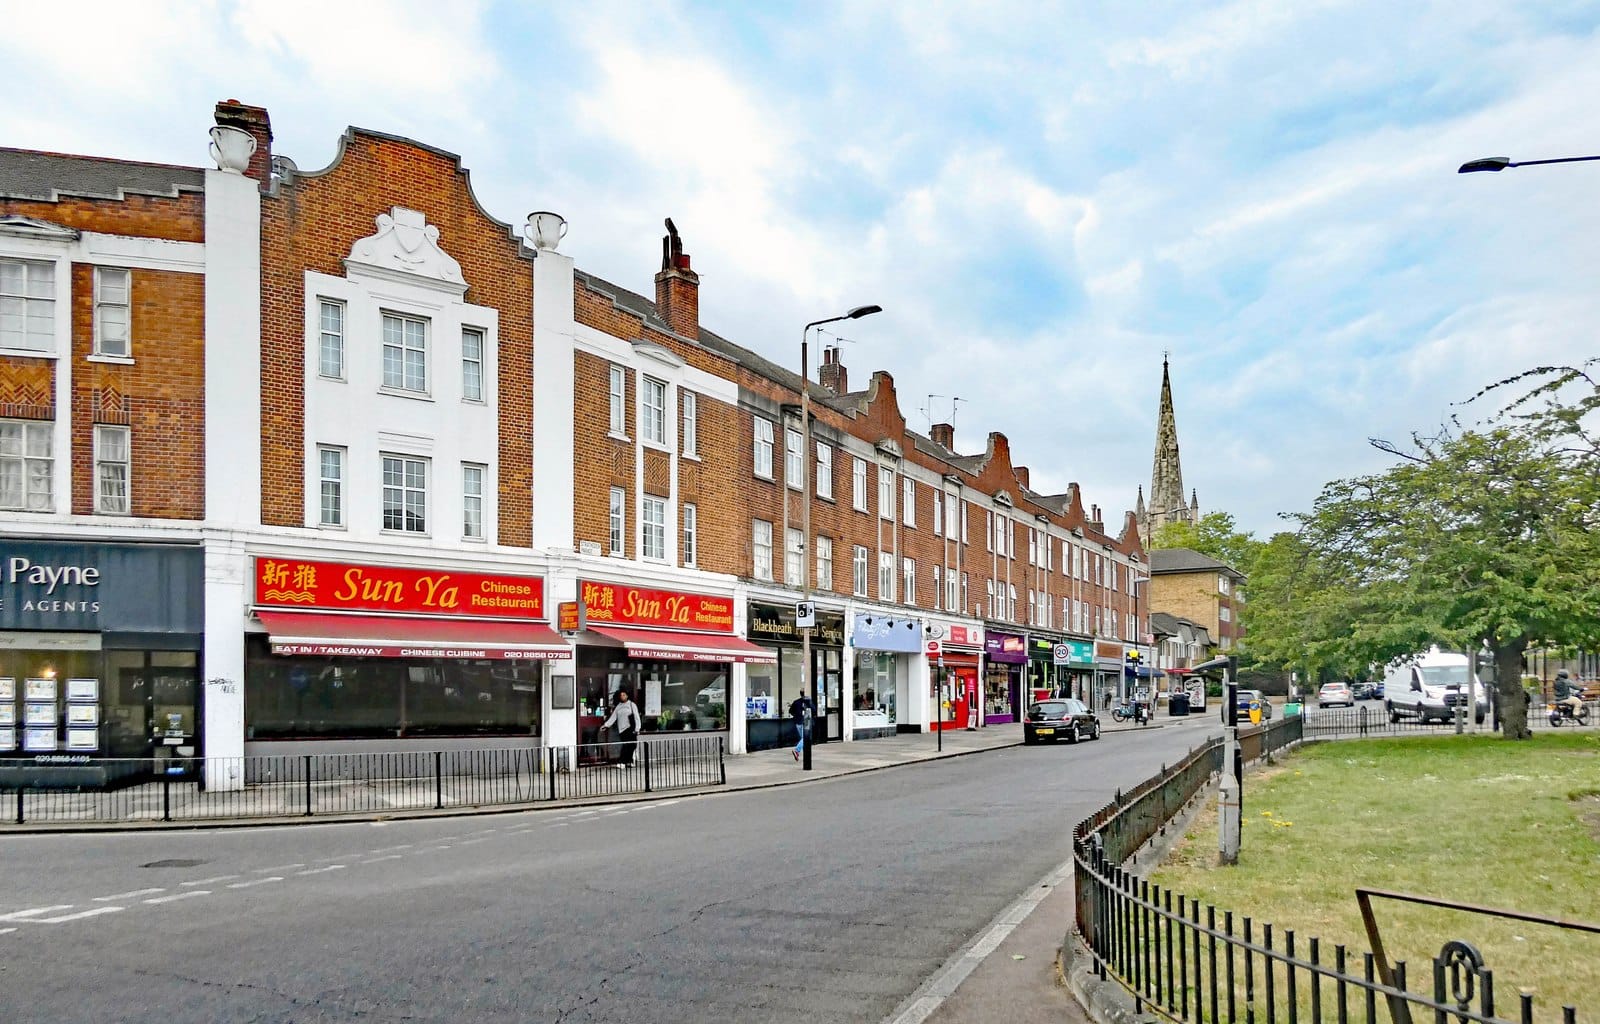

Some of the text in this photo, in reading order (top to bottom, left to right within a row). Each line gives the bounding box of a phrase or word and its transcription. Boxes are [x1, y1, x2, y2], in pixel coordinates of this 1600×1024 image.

[10, 557, 100, 595] Payne
[262, 560, 318, 590] 新雅
[334, 568, 459, 608] Sun Ya
[481, 580, 531, 595] Chinese
[471, 594, 539, 609] Restaurant
[584, 583, 614, 609] 新雅
[23, 600, 100, 613] AGENTS
[622, 590, 690, 624] Sun Ya
[700, 600, 728, 613] Chinese
[695, 611, 732, 625] Restaurant
[753, 618, 793, 635] Blackheath
[275, 645, 299, 653] EAT
[320, 646, 383, 655] TAKEAWAY
[1056, 647, 1066, 655] 20
